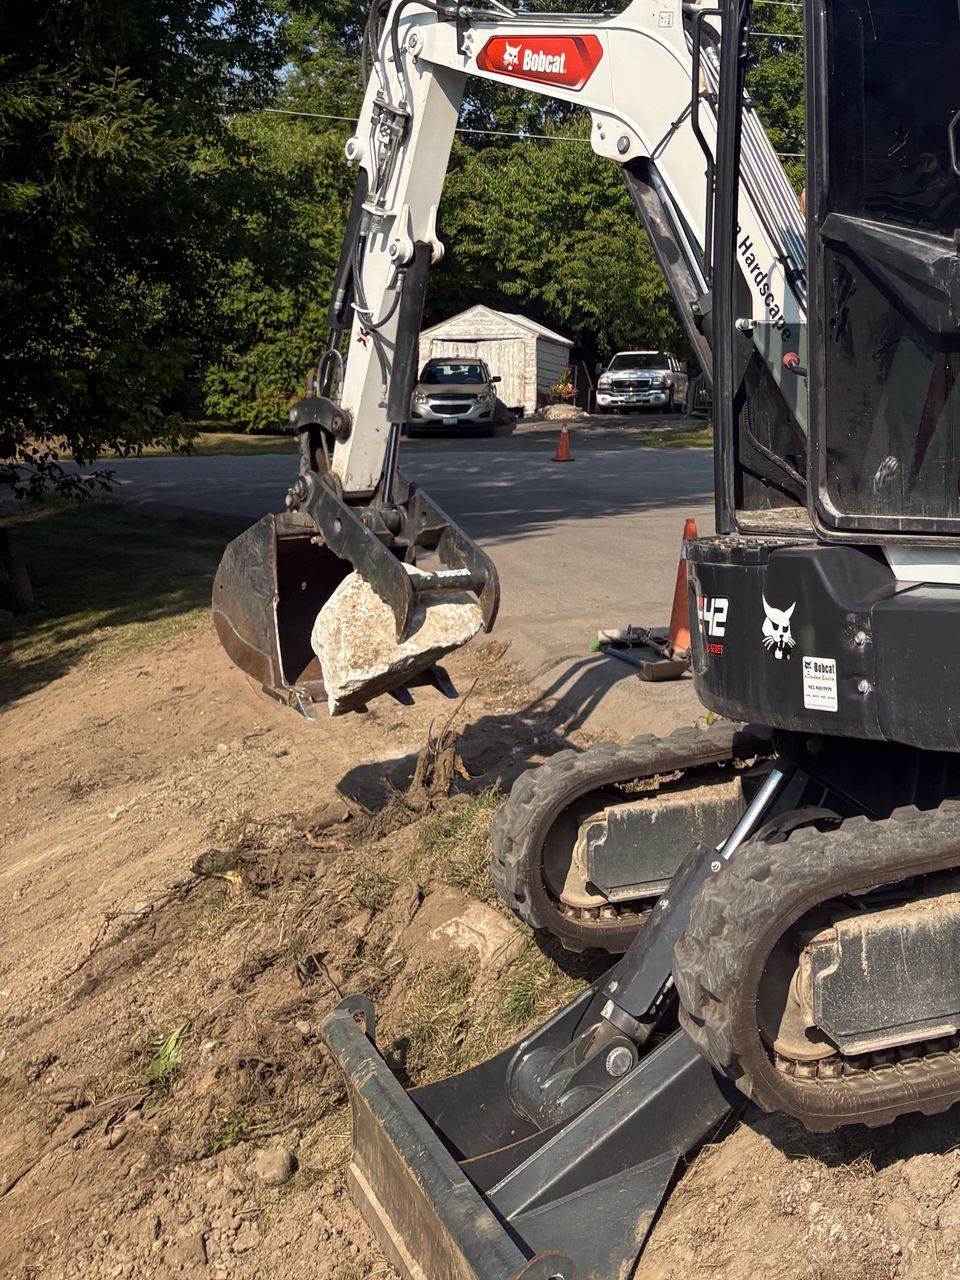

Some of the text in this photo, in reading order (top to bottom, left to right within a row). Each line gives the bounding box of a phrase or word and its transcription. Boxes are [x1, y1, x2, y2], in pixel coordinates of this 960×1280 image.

[522, 49, 566, 74] Bobcat
[738, 235, 791, 342] Hardscape
[813, 662, 835, 674] Bobcat
